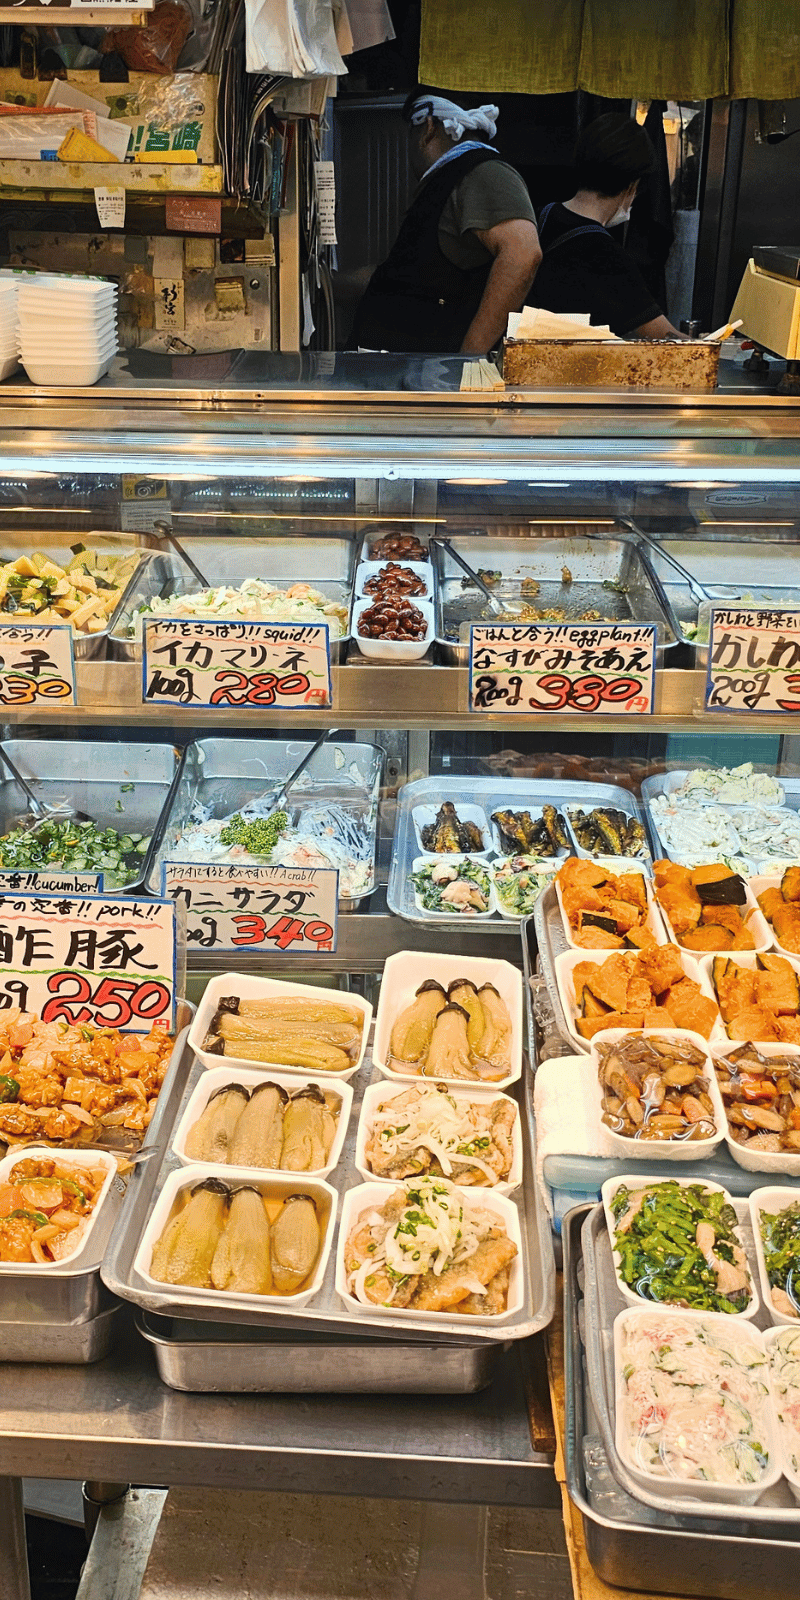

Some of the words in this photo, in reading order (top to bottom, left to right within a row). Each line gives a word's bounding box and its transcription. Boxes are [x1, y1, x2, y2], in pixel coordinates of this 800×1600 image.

[0, 628, 53, 642] 合う!!
[263, 627, 320, 643] squid!!
[0, 649, 58, 677] 子
[0, 674, 72, 705] 30
[146, 668, 201, 703] 100g
[96, 903, 162, 921] pork!!
[168, 886, 315, 913] カニサラダ
